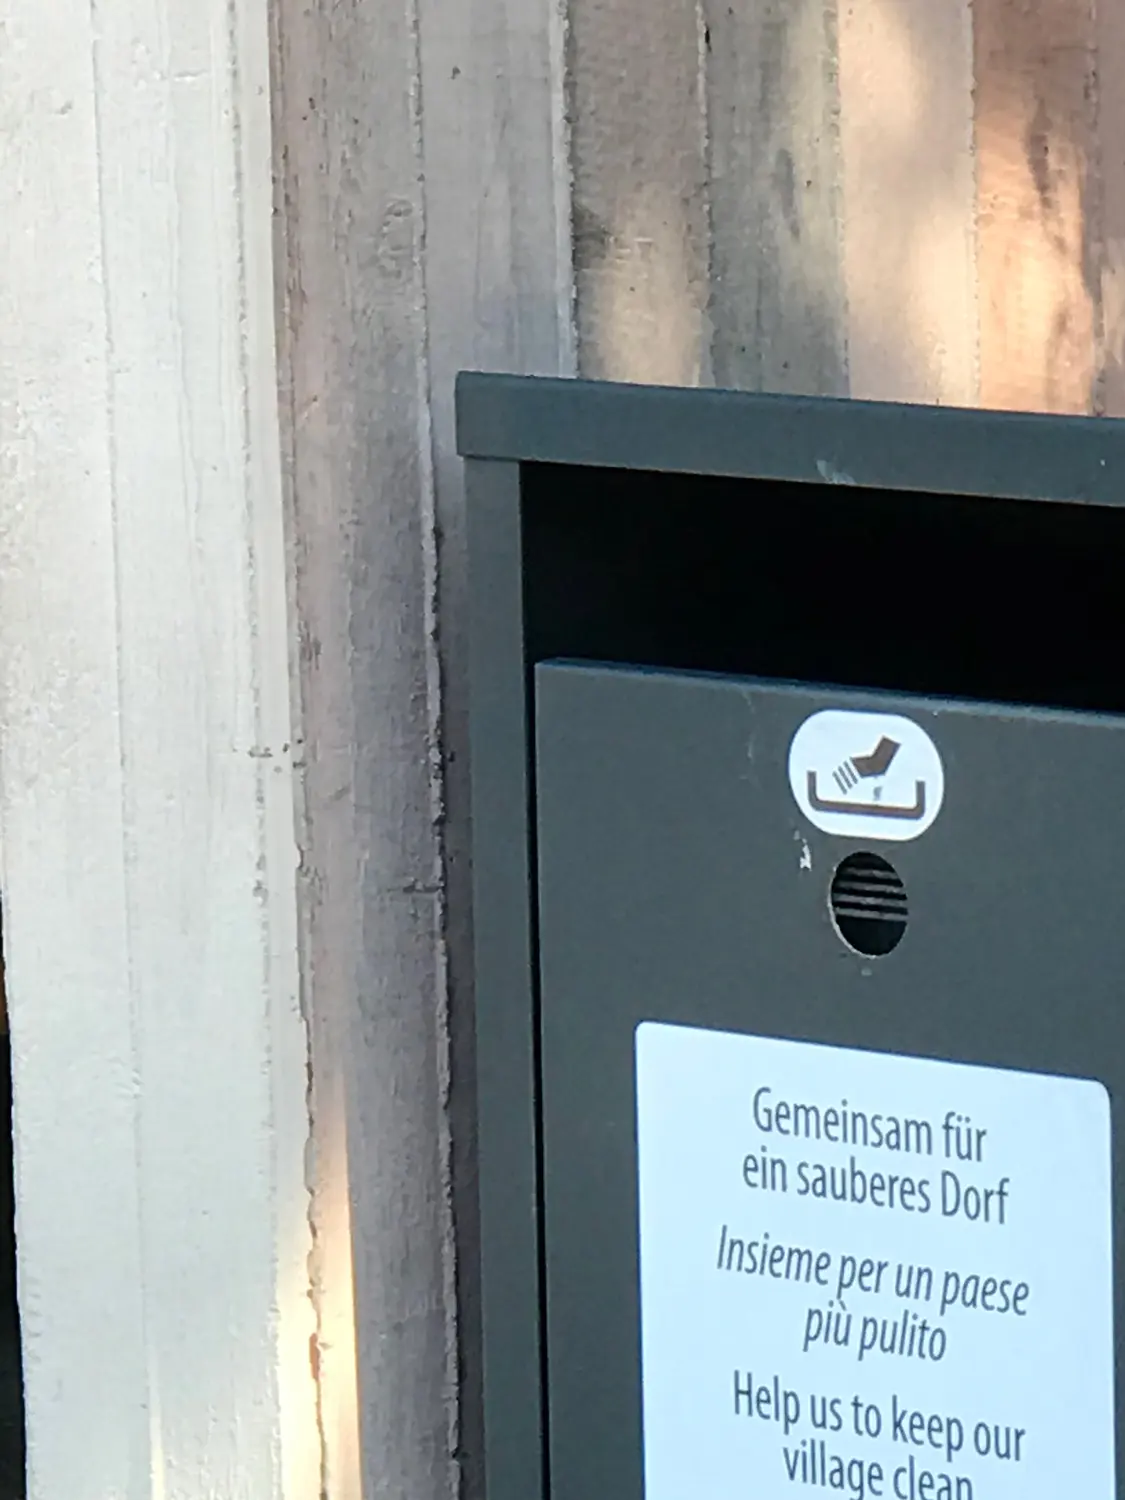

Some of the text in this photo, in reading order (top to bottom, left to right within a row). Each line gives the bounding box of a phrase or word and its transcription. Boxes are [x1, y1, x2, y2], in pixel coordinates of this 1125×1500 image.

[753, 1086, 987, 1163] Gemeinsam für
[742, 1145, 1010, 1225] ein sauberes Dorf
[717, 1224, 1030, 1317] Insieme per un paese
[802, 1299, 947, 1362] più pulito
[733, 1369, 1026, 1463] Help us to keep our
